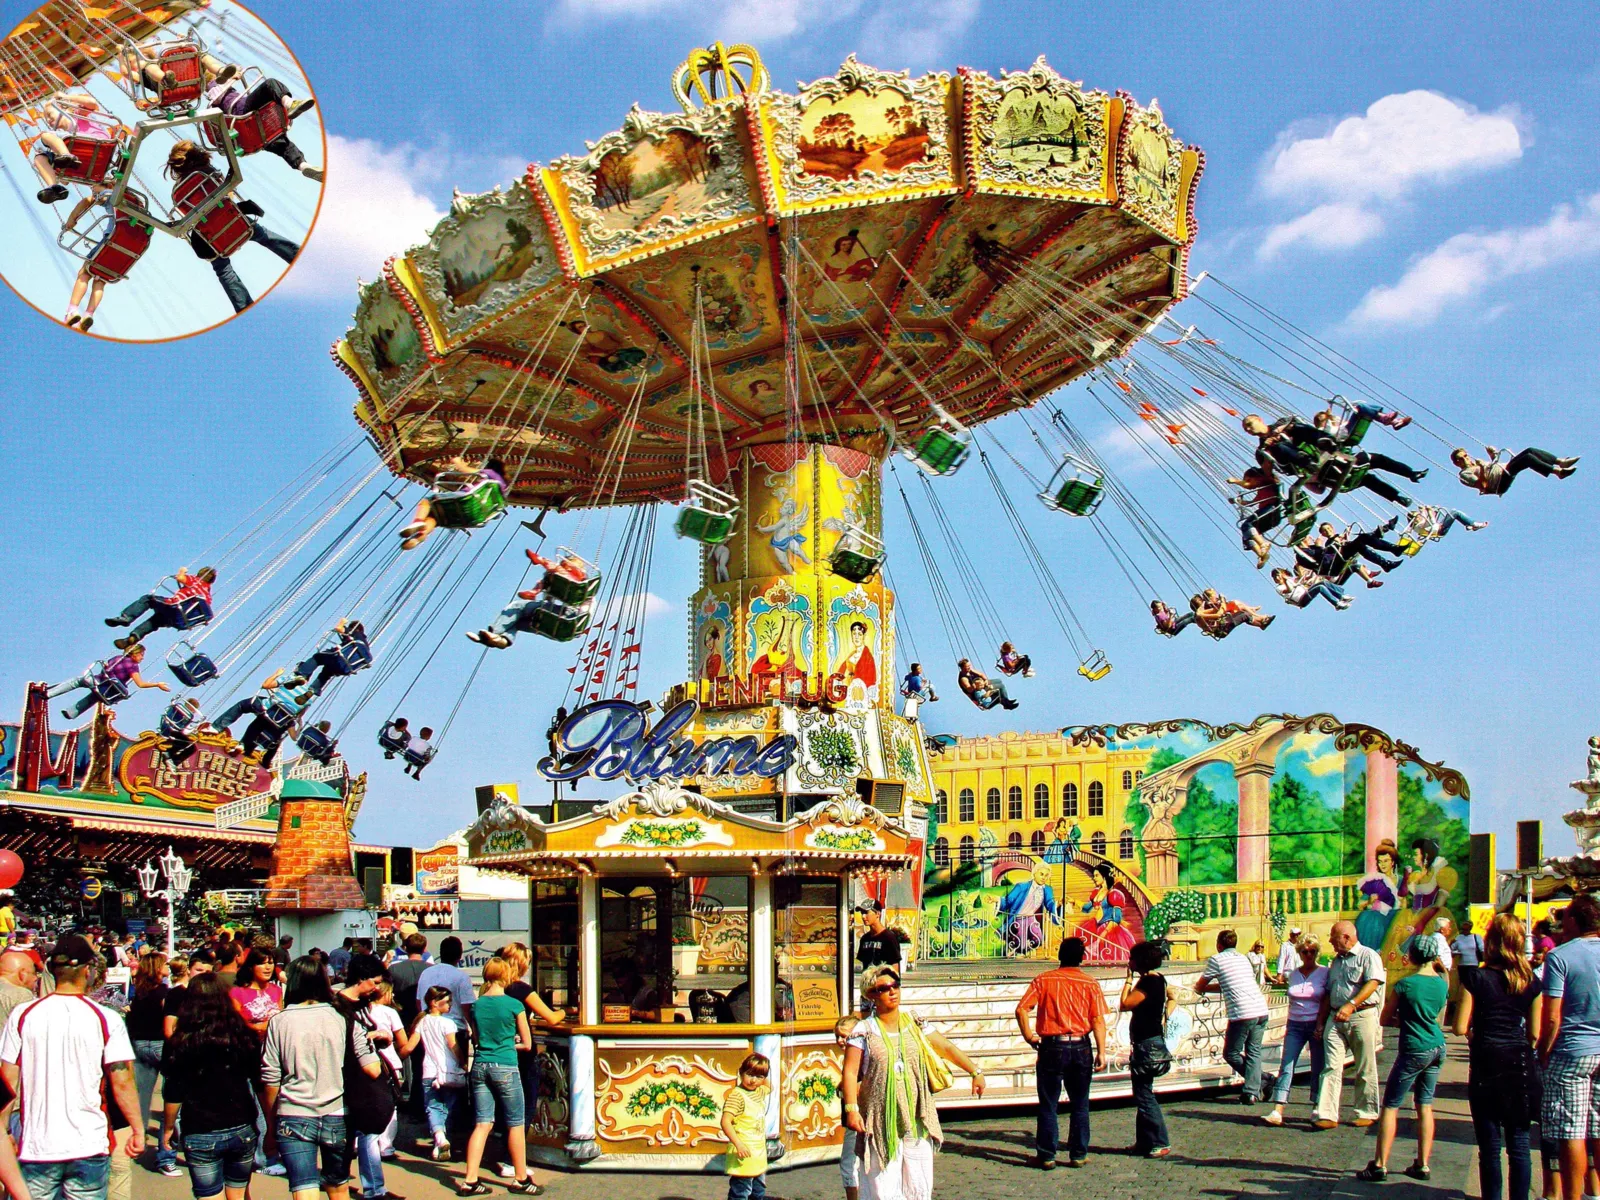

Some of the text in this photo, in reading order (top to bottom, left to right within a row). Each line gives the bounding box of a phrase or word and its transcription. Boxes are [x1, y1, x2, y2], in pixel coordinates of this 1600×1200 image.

[536, 698, 799, 782] Blume
[198, 749, 259, 783] PREIS
[154, 768, 250, 799] IST HEISS
